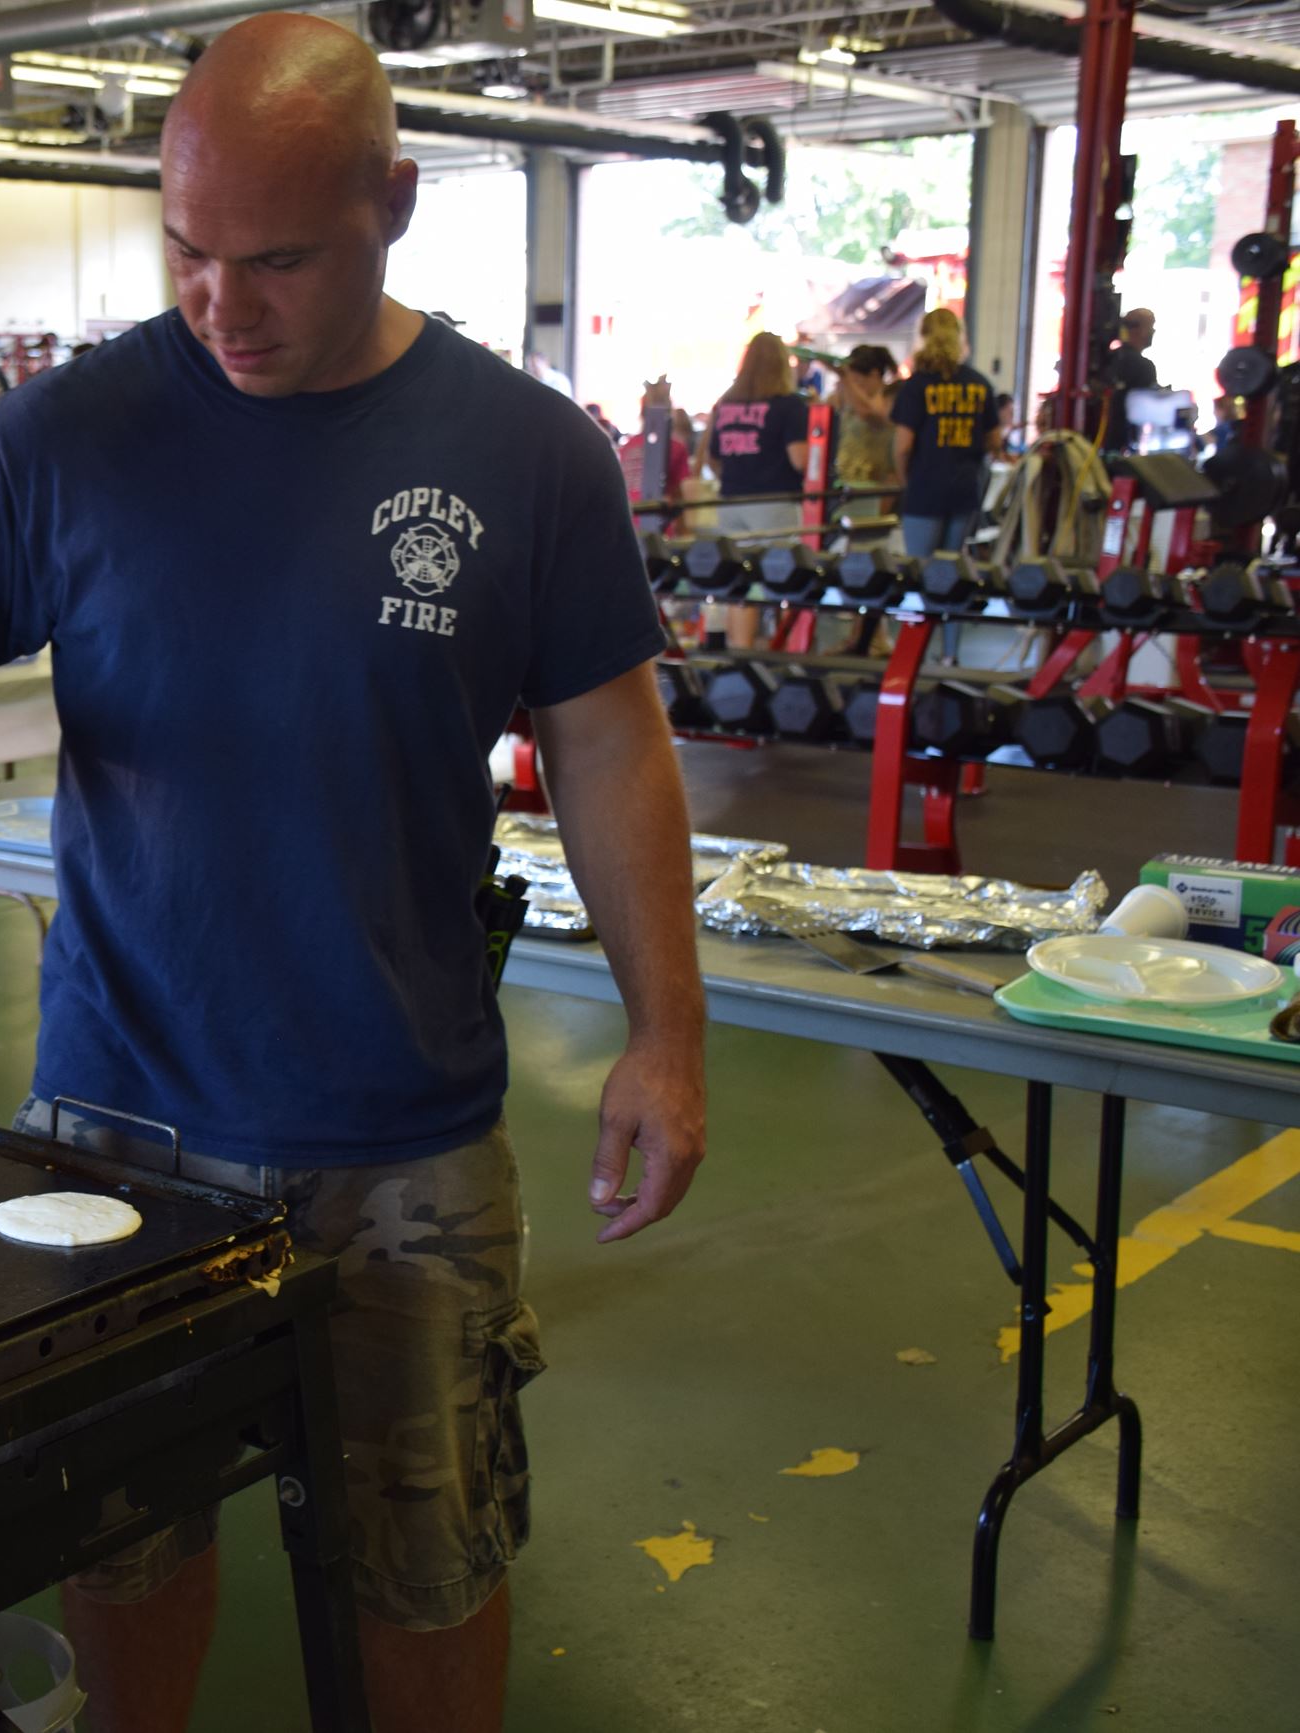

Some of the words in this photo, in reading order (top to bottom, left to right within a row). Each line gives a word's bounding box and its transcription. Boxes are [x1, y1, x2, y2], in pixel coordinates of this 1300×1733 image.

[924, 384, 987, 415] COPLEY
[937, 416, 974, 448] FIRE
[371, 487, 485, 551] COPLEY
[378, 596, 458, 637] FIRE
[1187, 906, 1225, 918] ERVICE
